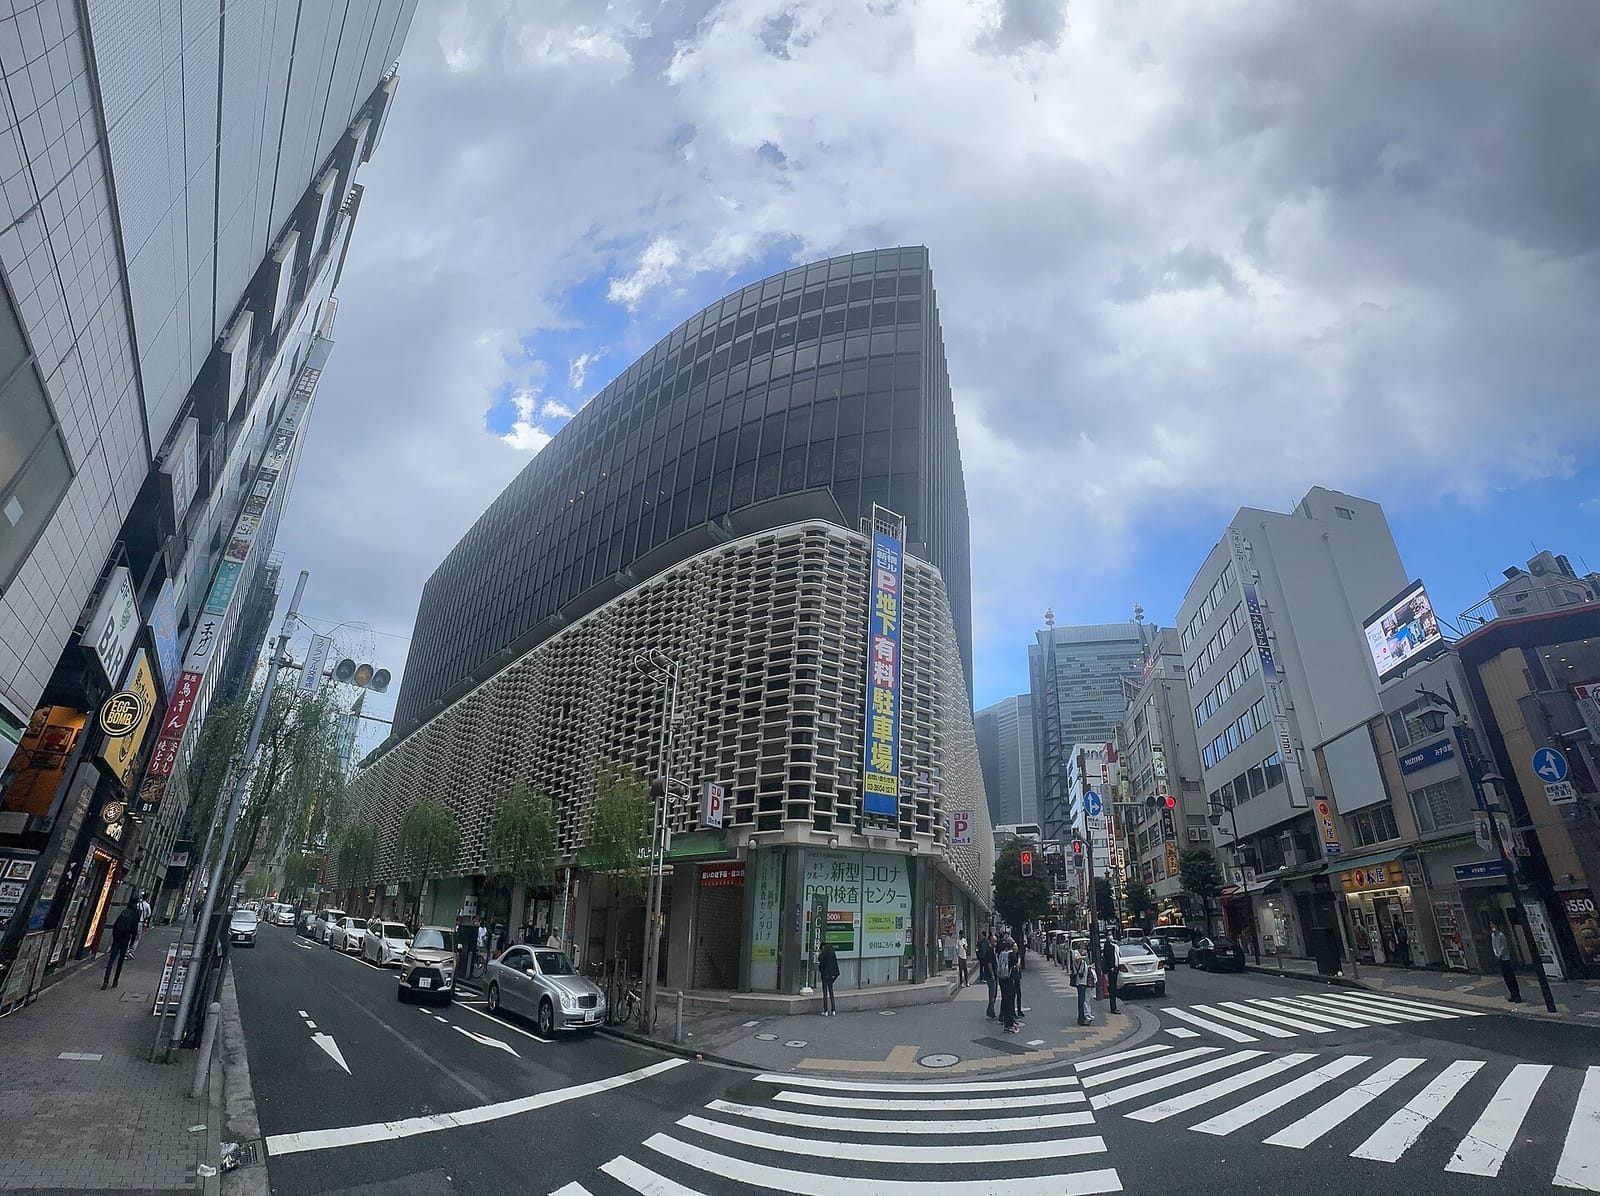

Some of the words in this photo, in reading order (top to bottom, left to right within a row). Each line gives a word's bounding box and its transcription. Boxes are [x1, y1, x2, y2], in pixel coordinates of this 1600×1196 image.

[98, 616, 124, 683] BAR
[111, 700, 131, 713] EGG
[107, 711, 132, 726] BOMB
[711, 796, 720, 816] P
[954, 820, 968, 838] P
